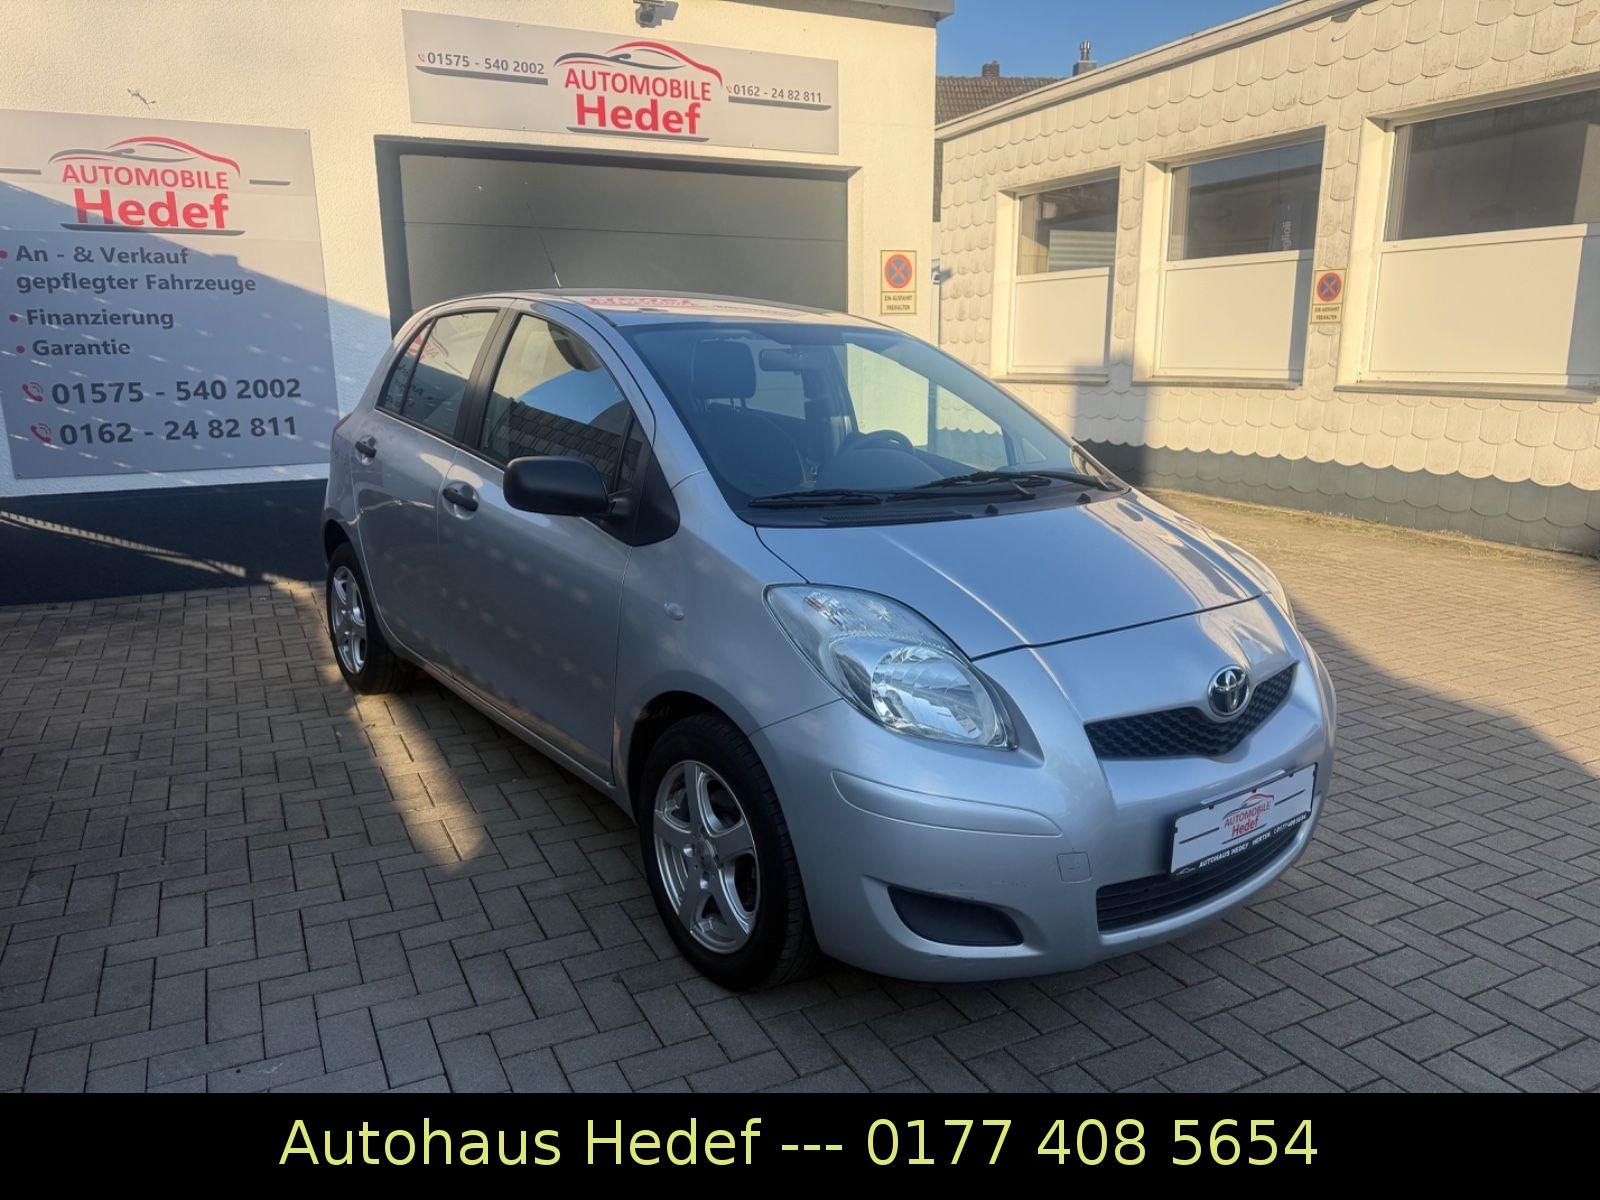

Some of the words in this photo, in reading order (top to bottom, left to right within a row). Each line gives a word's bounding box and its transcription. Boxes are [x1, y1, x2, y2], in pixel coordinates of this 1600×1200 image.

[427, 51, 470, 68] 01575
[484, 57, 509, 72] 540
[513, 60, 545, 75] 2002
[564, 68, 712, 102] AUTOMOBILE
[733, 84, 760, 97] 0162
[771, 88, 785, 99] 24
[787, 90, 800, 101] 82
[803, 91, 821, 103] 811
[576, 93, 701, 135] Hedef
[62, 164, 229, 190] AUTOMOBILE
[74, 188, 229, 229] Hedef
[16, 245, 48, 262] An
[73, 246, 94, 262] &
[100, 247, 189, 264] Verkauf
[16, 272, 138, 294] gepflegter
[146, 274, 256, 295] Fahrzeuge
[26, 309, 175, 329] Finanzierung
[32, 339, 131, 356] Garantie
[51, 382, 144, 405] 01575
[176, 380, 227, 401] 540
[236, 378, 301, 399] 2002
[59, 422, 134, 446] 0162
[164, 420, 199, 441] 24
[208, 418, 241, 438] 82
[250, 416, 297, 437] 811
[1231, 817, 1259, 837] Hedef
